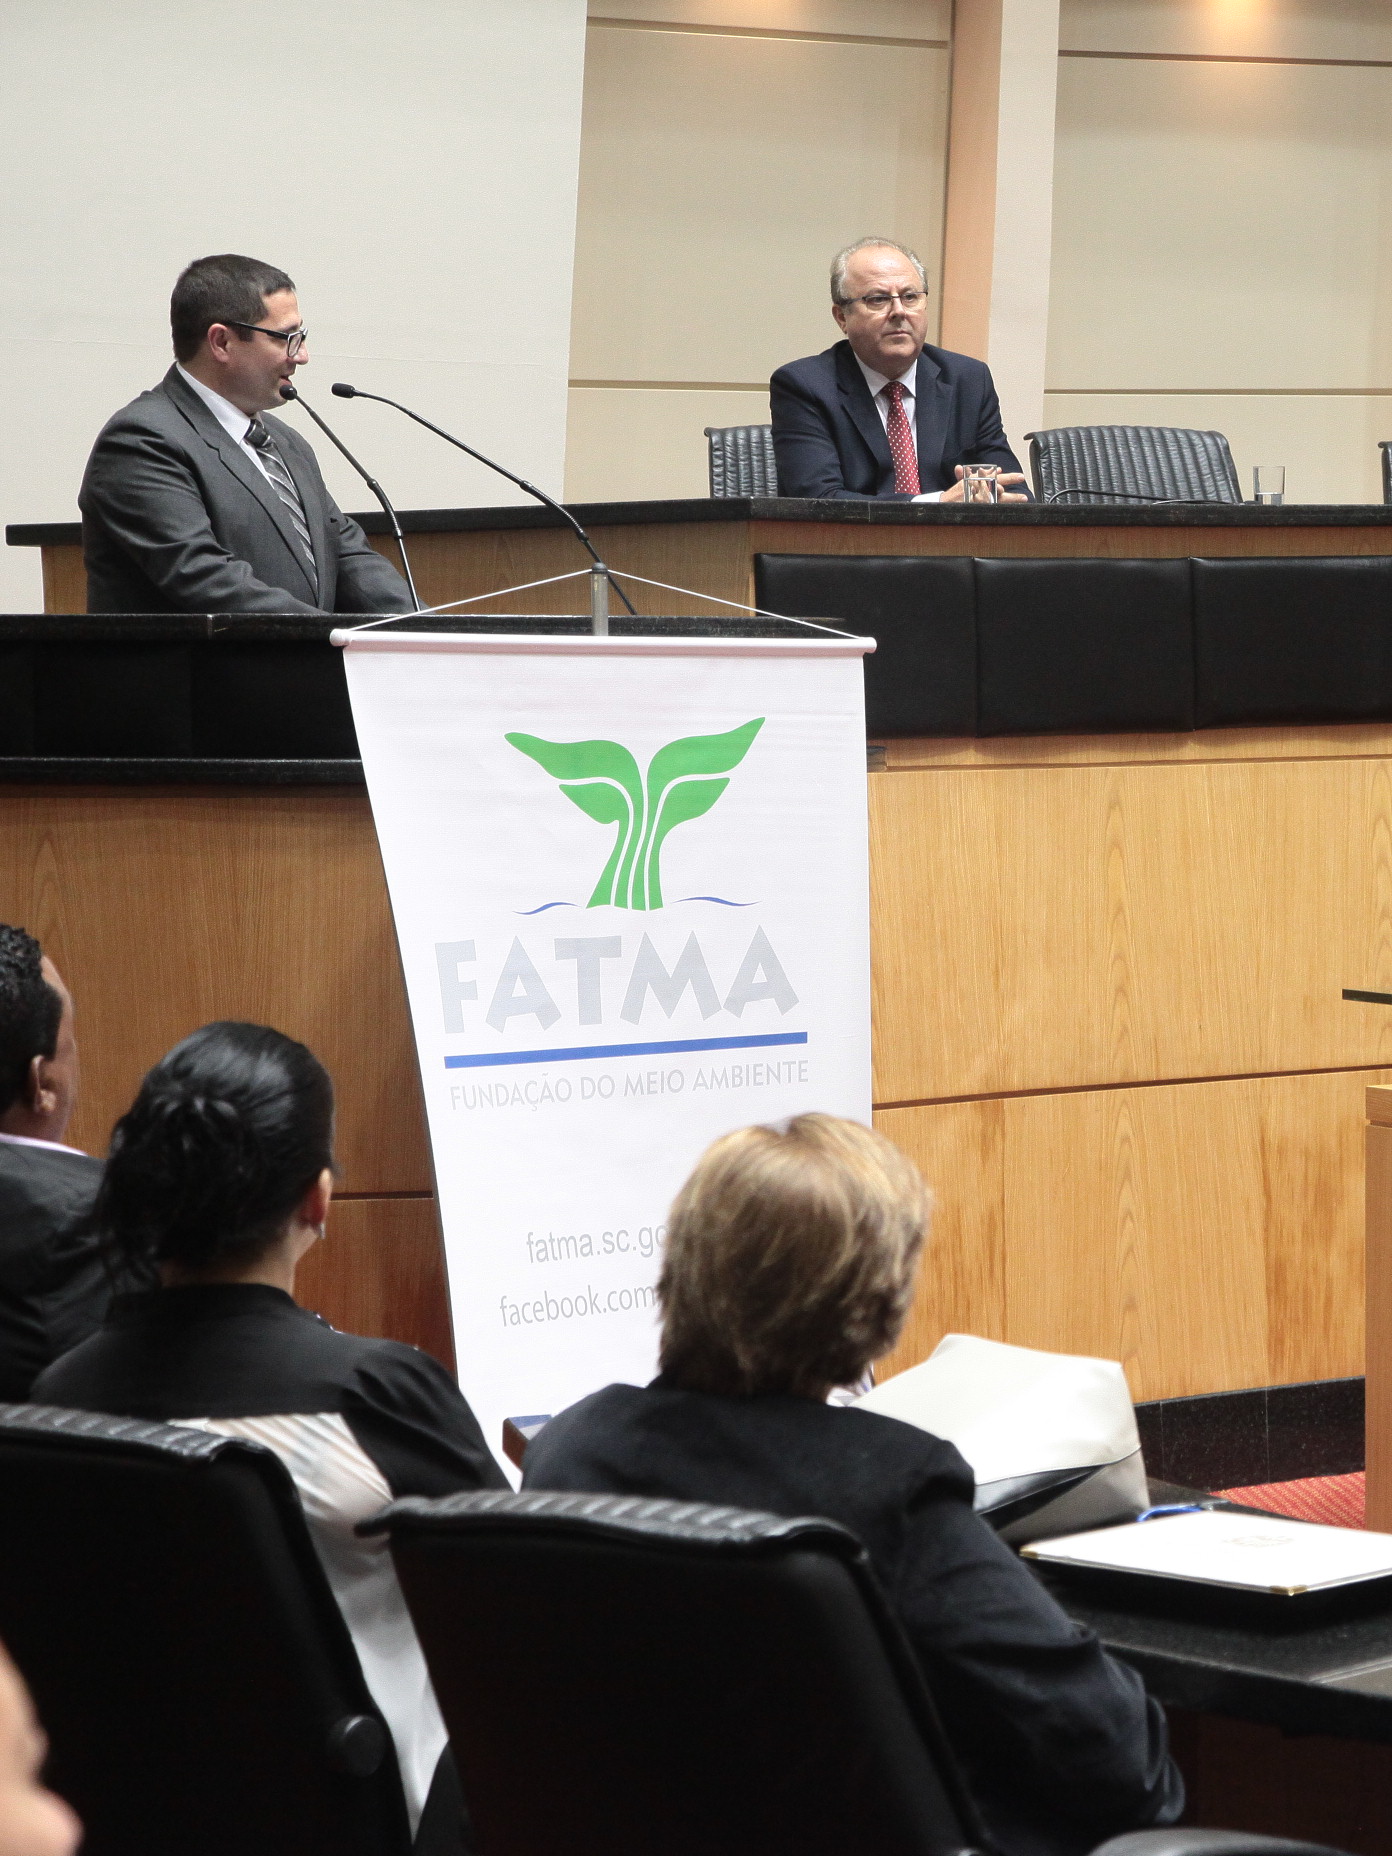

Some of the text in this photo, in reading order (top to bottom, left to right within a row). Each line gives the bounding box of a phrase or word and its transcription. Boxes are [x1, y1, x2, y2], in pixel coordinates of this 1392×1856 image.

[435, 924, 800, 1034] FATMA
[450, 1060, 810, 1112] FUNDAÇÃO DO MEIO AMBIENTE
